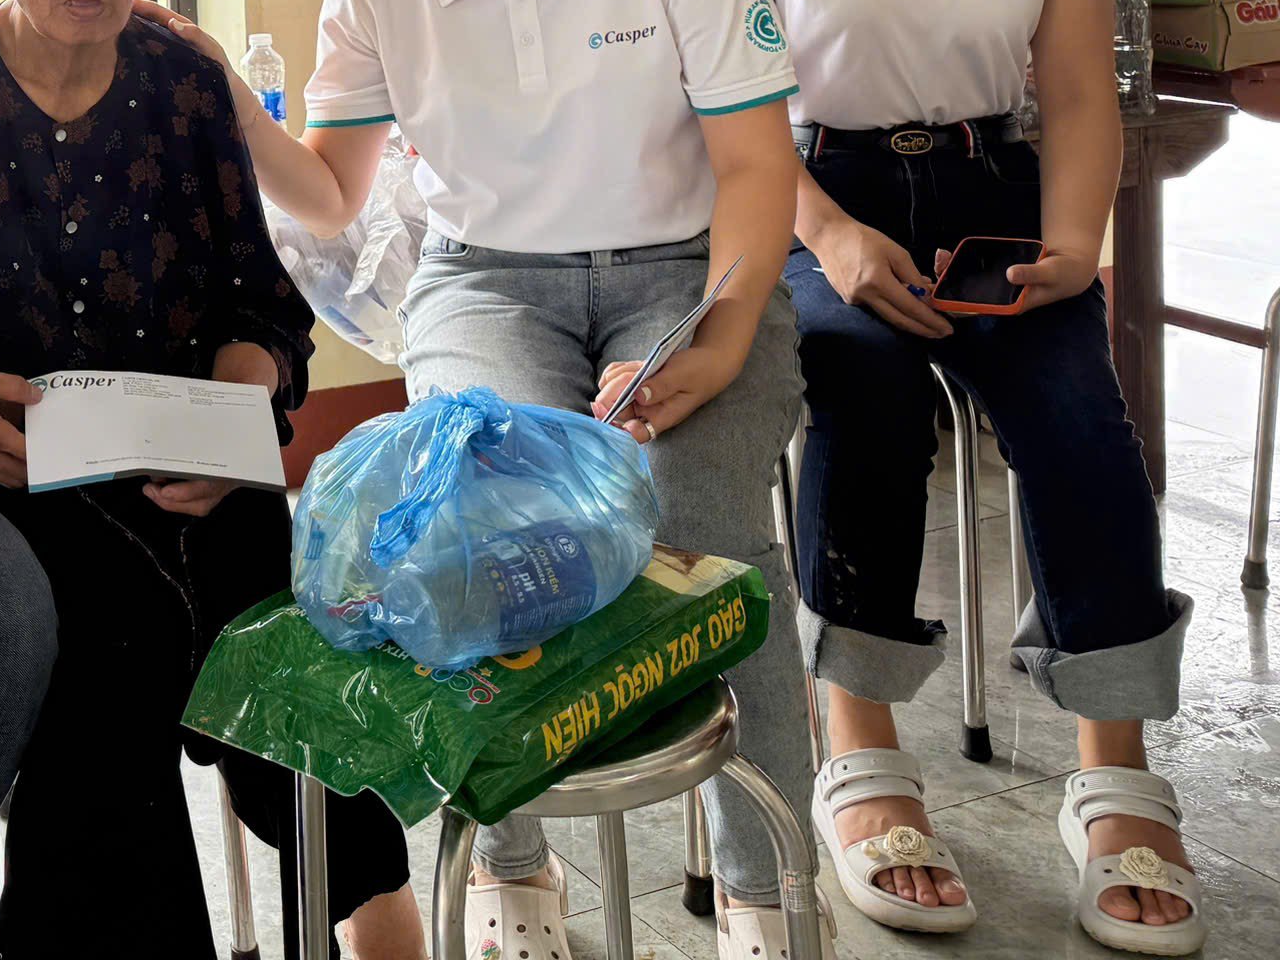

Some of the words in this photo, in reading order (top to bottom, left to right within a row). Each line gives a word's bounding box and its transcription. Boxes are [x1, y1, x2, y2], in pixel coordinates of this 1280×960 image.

[1236, 0, 1277, 25] Gấu
[604, 24, 657, 45] Casper
[49, 374, 117, 390] Casper
[518, 572, 537, 593] pH
[707, 596, 747, 650] GẠO
[603, 650, 665, 721] NGỌC
